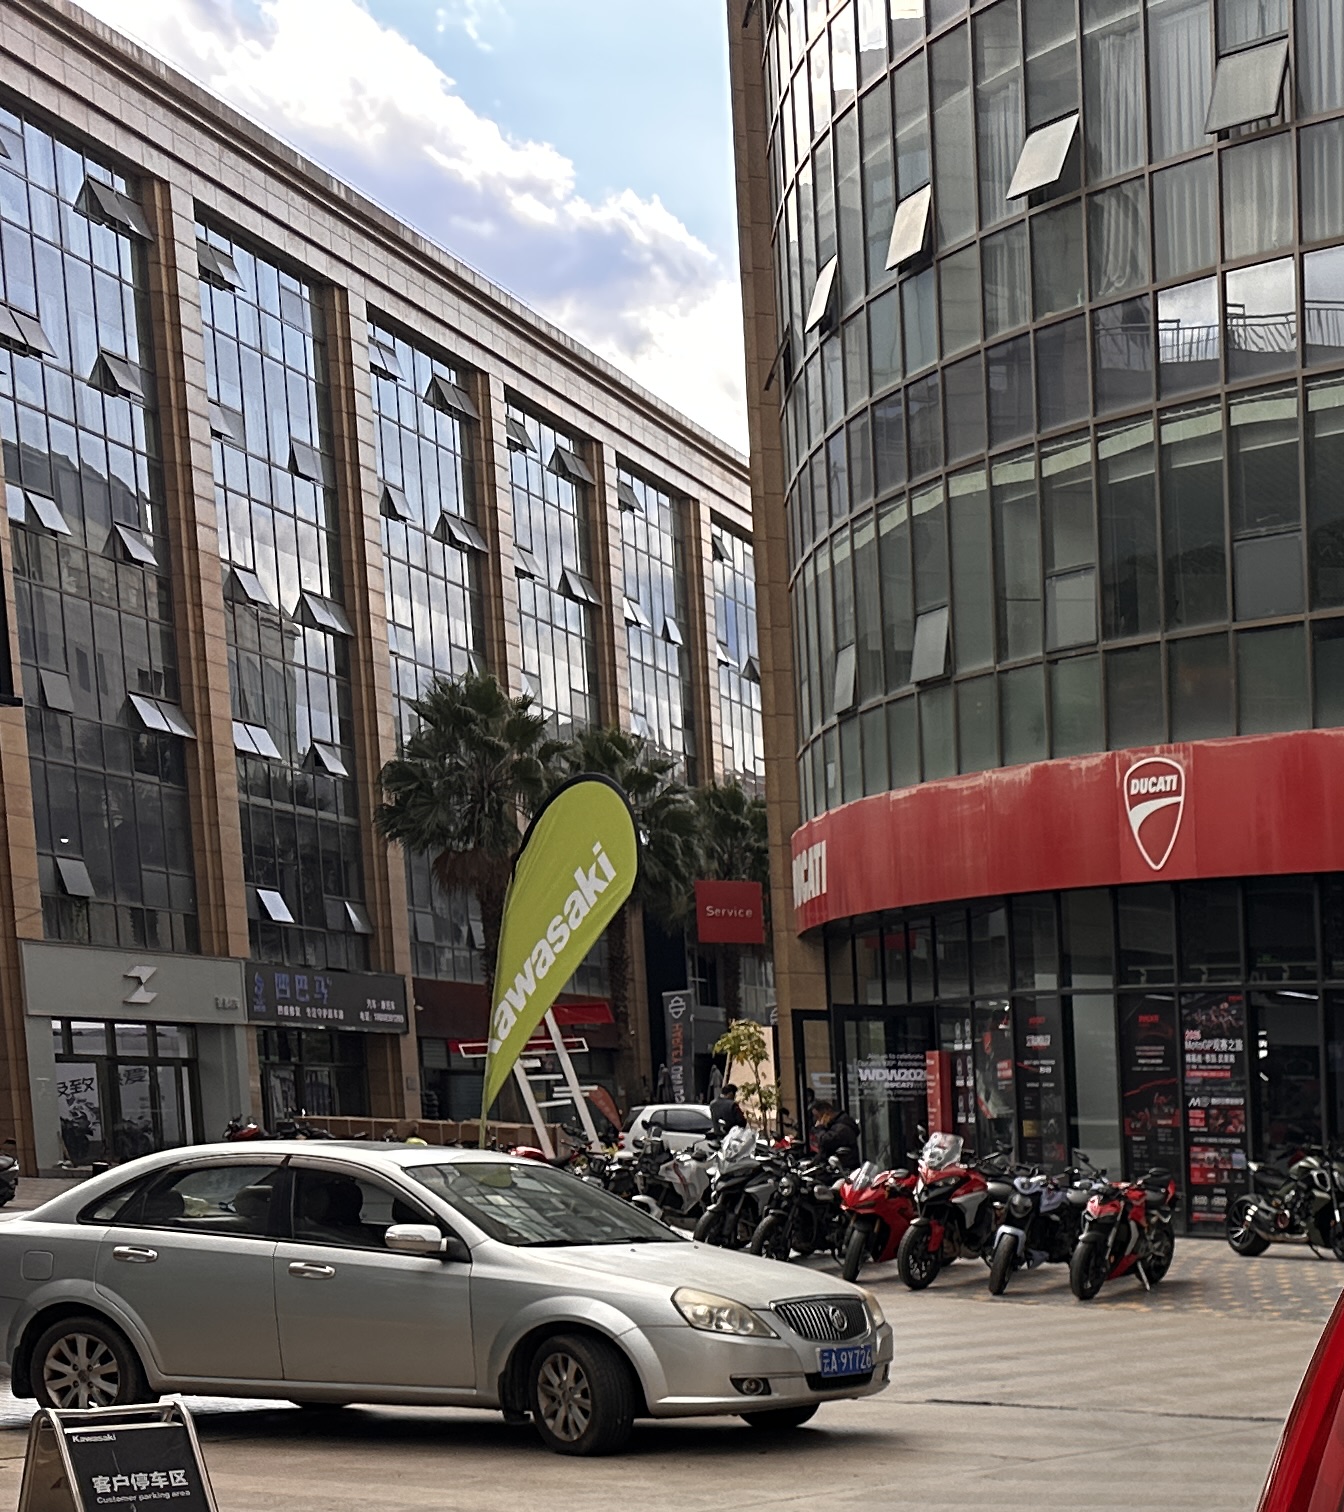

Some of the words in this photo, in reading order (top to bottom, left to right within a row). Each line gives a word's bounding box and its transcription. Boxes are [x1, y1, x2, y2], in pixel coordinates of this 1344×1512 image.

[1130, 774, 1178, 796] DUCATI
[705, 905, 753, 918] Service
[72, 1432, 117, 1444] Kawasaki
[91, 1469, 189, 1494] 客户停车区
[96, 1494, 137, 1505] Customer
[138, 1491, 171, 1503] parking
[171, 1489, 191, 1498] area
